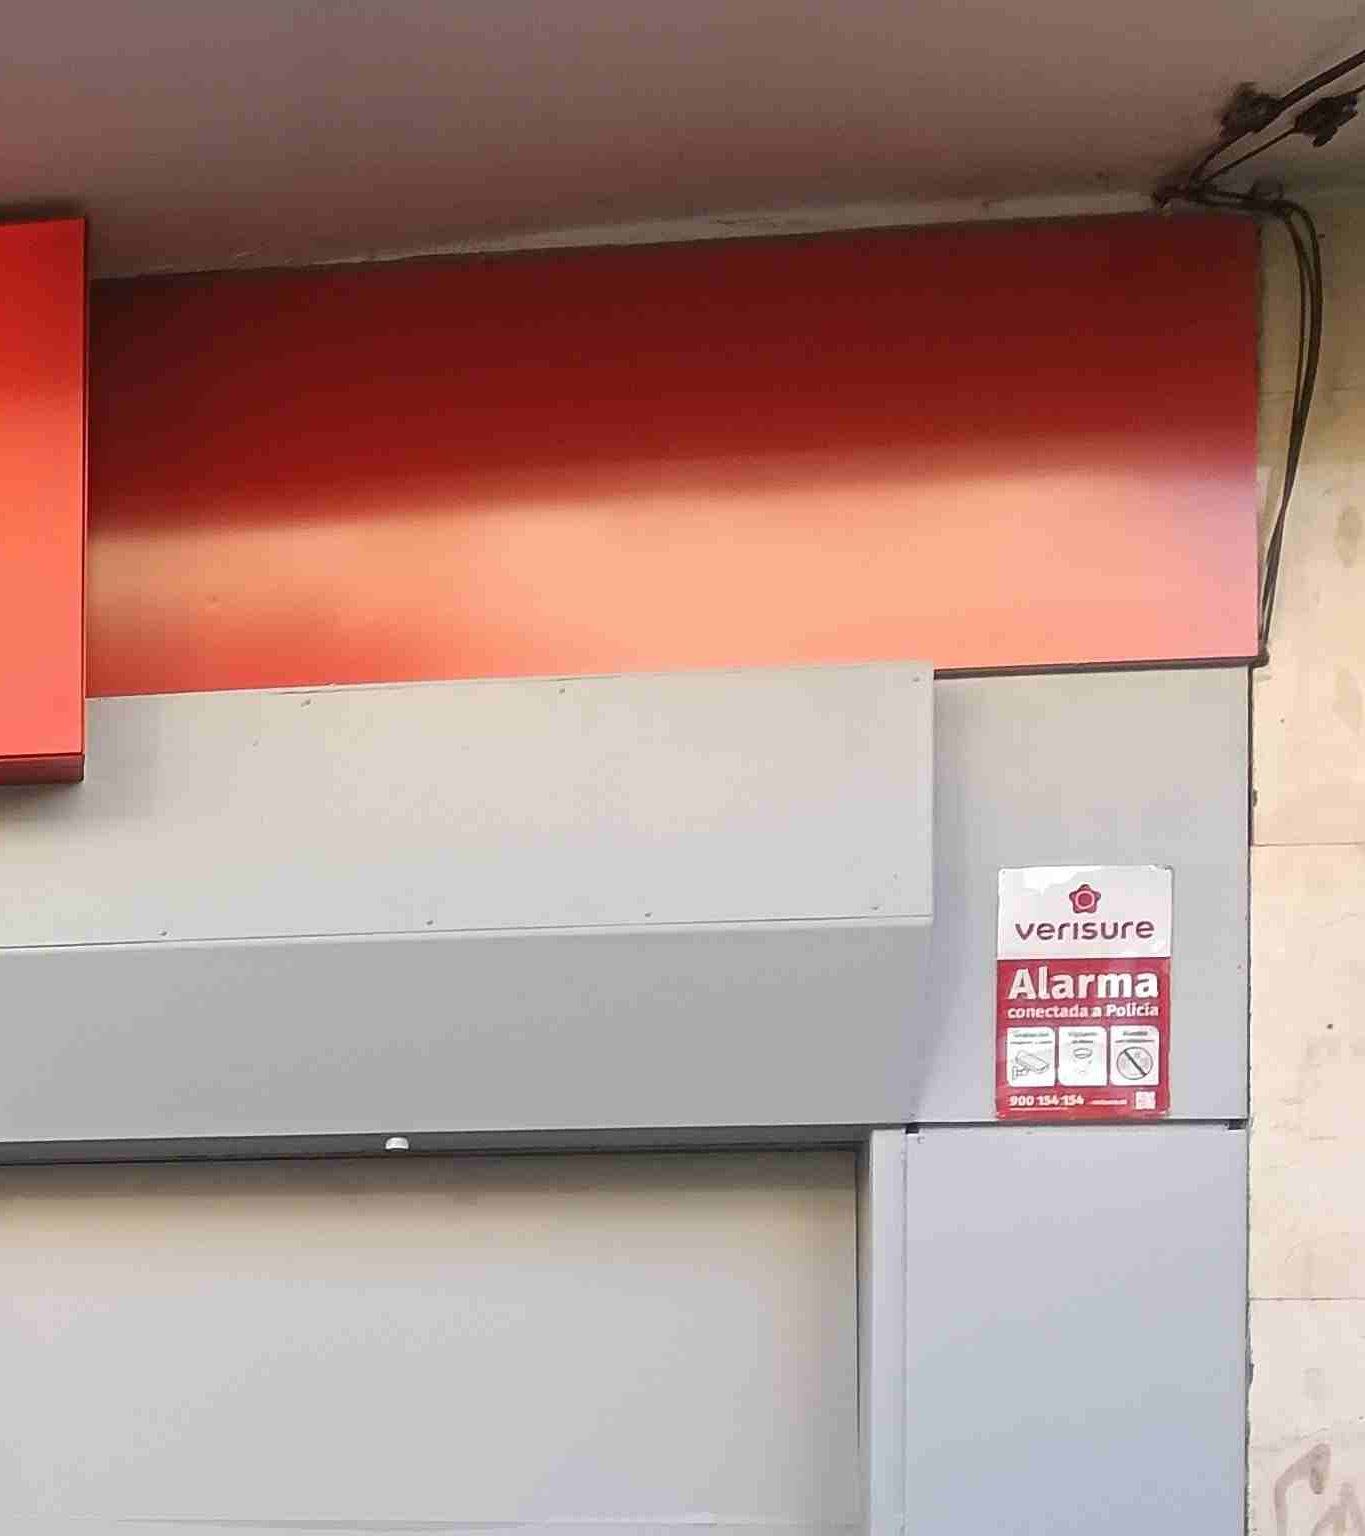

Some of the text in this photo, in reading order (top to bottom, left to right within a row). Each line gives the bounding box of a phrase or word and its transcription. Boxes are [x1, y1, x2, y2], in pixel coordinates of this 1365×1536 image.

[1015, 920, 1155, 941] verisure
[1008, 966, 1159, 1000] Alarma
[1007, 1002, 1159, 1019] conectada a Policía
[1009, 1095, 1034, 1107] 900
